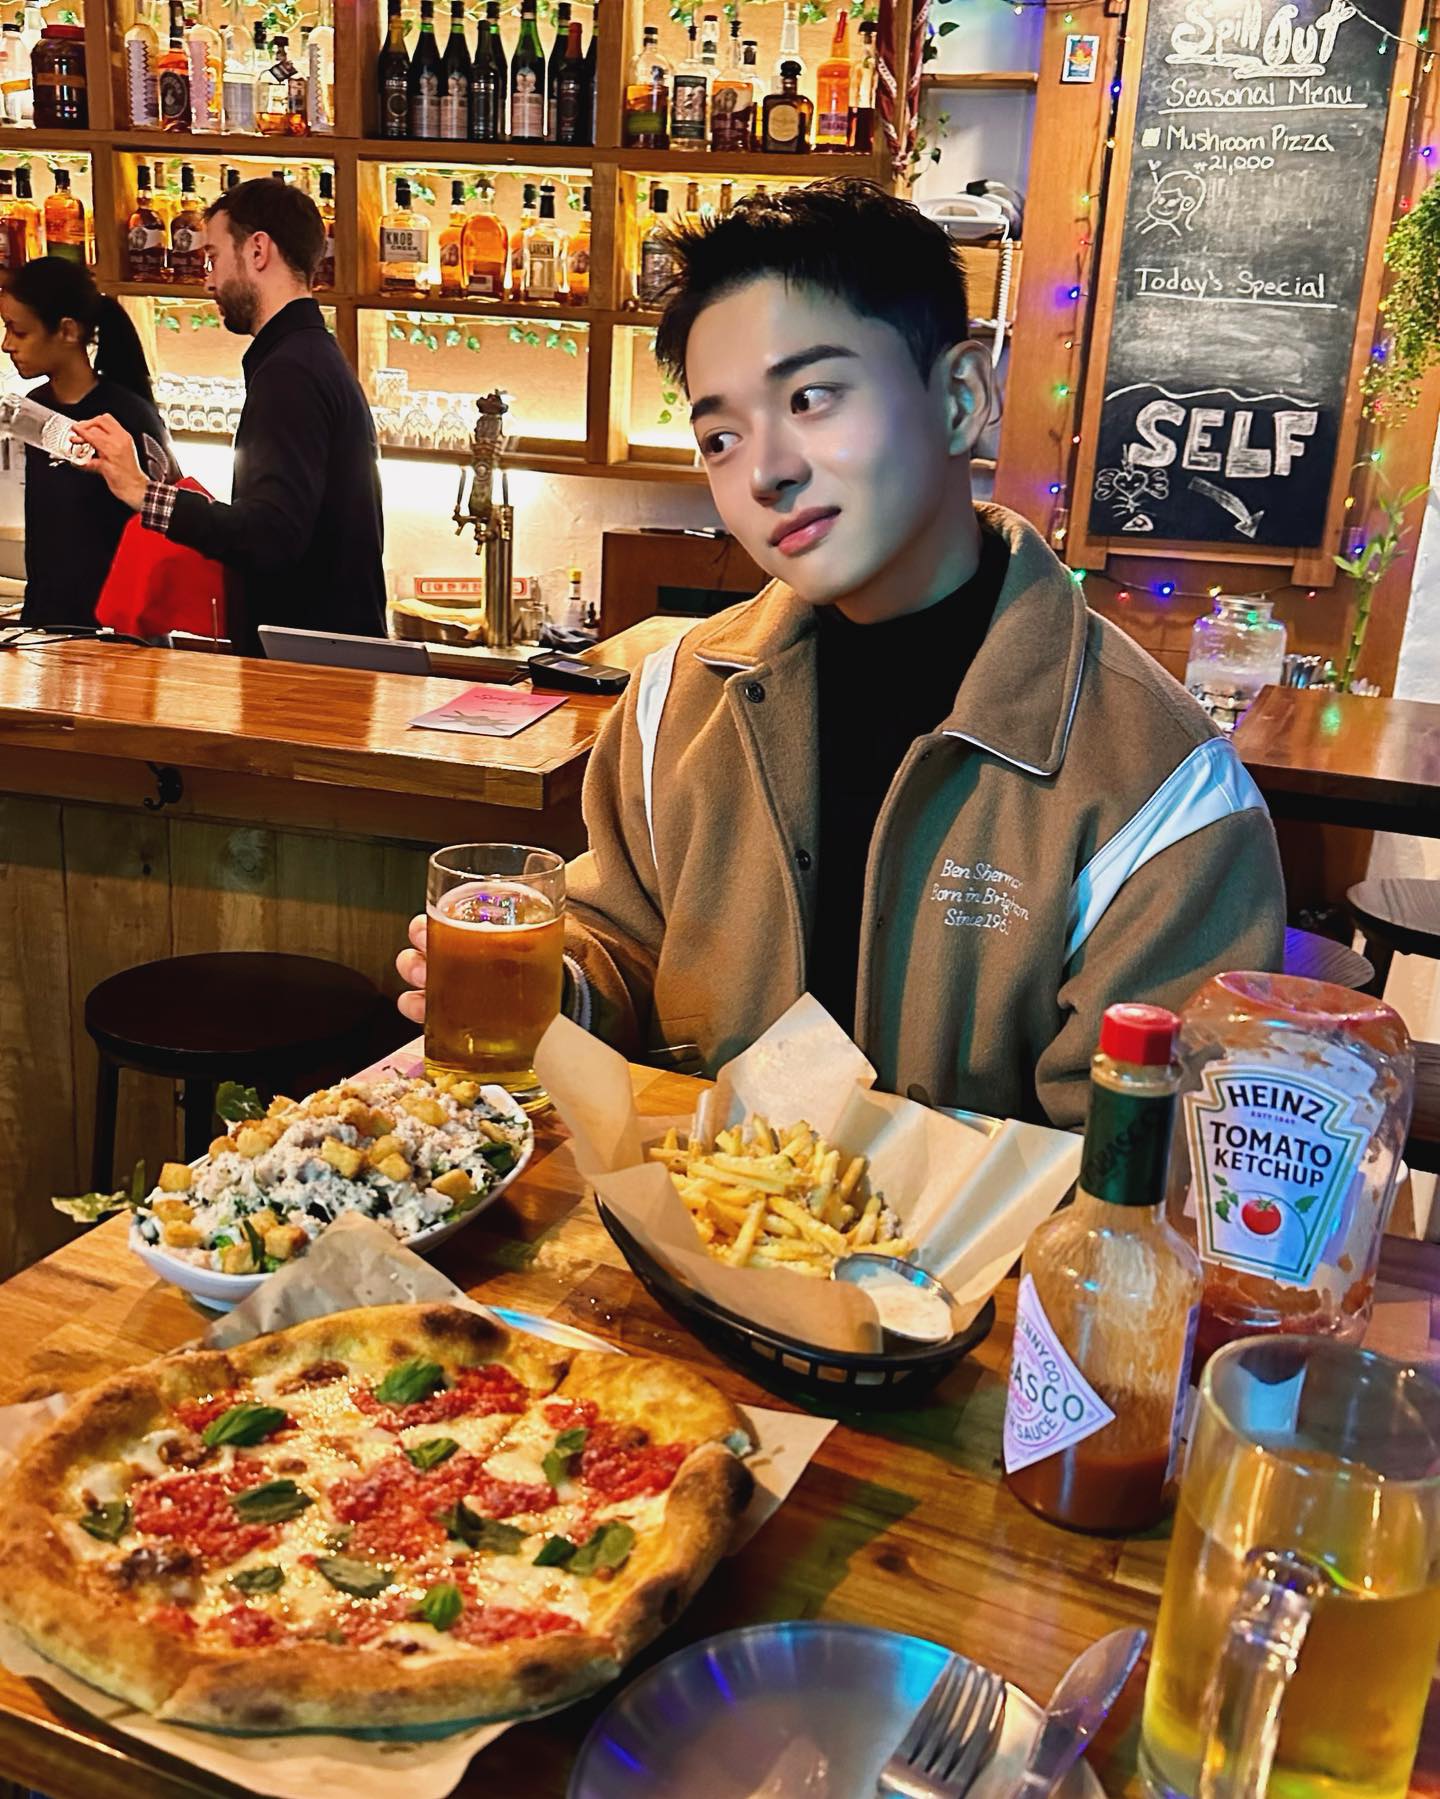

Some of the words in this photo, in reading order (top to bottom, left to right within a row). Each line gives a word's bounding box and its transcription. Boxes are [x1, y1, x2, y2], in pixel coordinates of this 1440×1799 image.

[1171, 0, 1263, 60] Spill
[1262, 0, 1357, 66] Out
[1166, 78, 1275, 107] Seasonal
[1288, 79, 1353, 105] Menu
[1166, 124, 1265, 152] Mushroom
[1271, 123, 1336, 152] Pizza
[386, 231, 413, 246] KNOB
[1134, 267, 1222, 299] Today's
[1236, 270, 1326, 300] Special
[1128, 399, 1319, 479] SELF
[940, 859, 970, 879] Ben
[973, 863, 1024, 889] Sherma
[965, 887, 981, 903] in
[944, 908, 983, 927] Since
[1227, 1084, 1324, 1124] HEINZ
[1209, 1121, 1332, 1168] TOMATO
[1214, 1148, 1325, 1188] KETCHUP
[1043, 1359, 1061, 1383] CO
[1016, 1414, 1058, 1441] SAUCE
